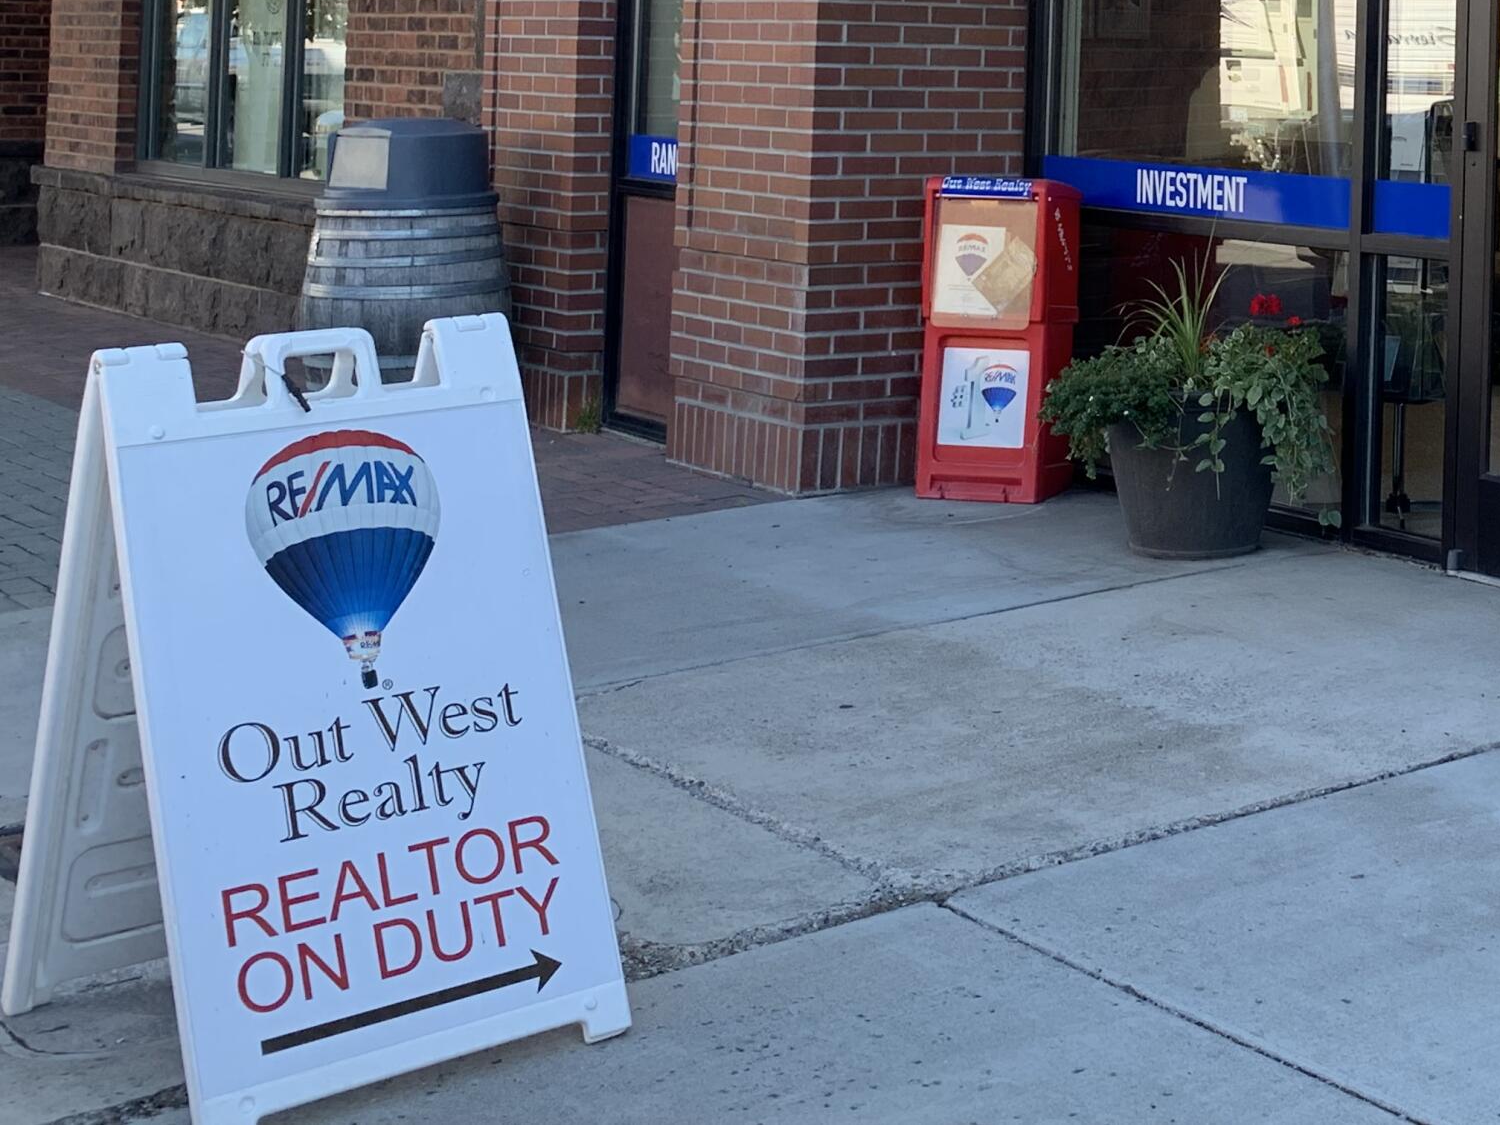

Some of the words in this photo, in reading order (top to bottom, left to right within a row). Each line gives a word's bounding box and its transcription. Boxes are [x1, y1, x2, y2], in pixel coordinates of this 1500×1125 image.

[651, 141, 679, 176] RAN
[993, 178, 1032, 195] Realty
[1136, 168, 1248, 213] INVESTMENT
[266, 459, 417, 527] RE/MAX
[217, 718, 352, 786] Out
[363, 682, 523, 749] West
[275, 760, 486, 842] Realty
[221, 815, 560, 948] REALTOR
[237, 933, 349, 1013] ON
[374, 877, 559, 980] DUTY
